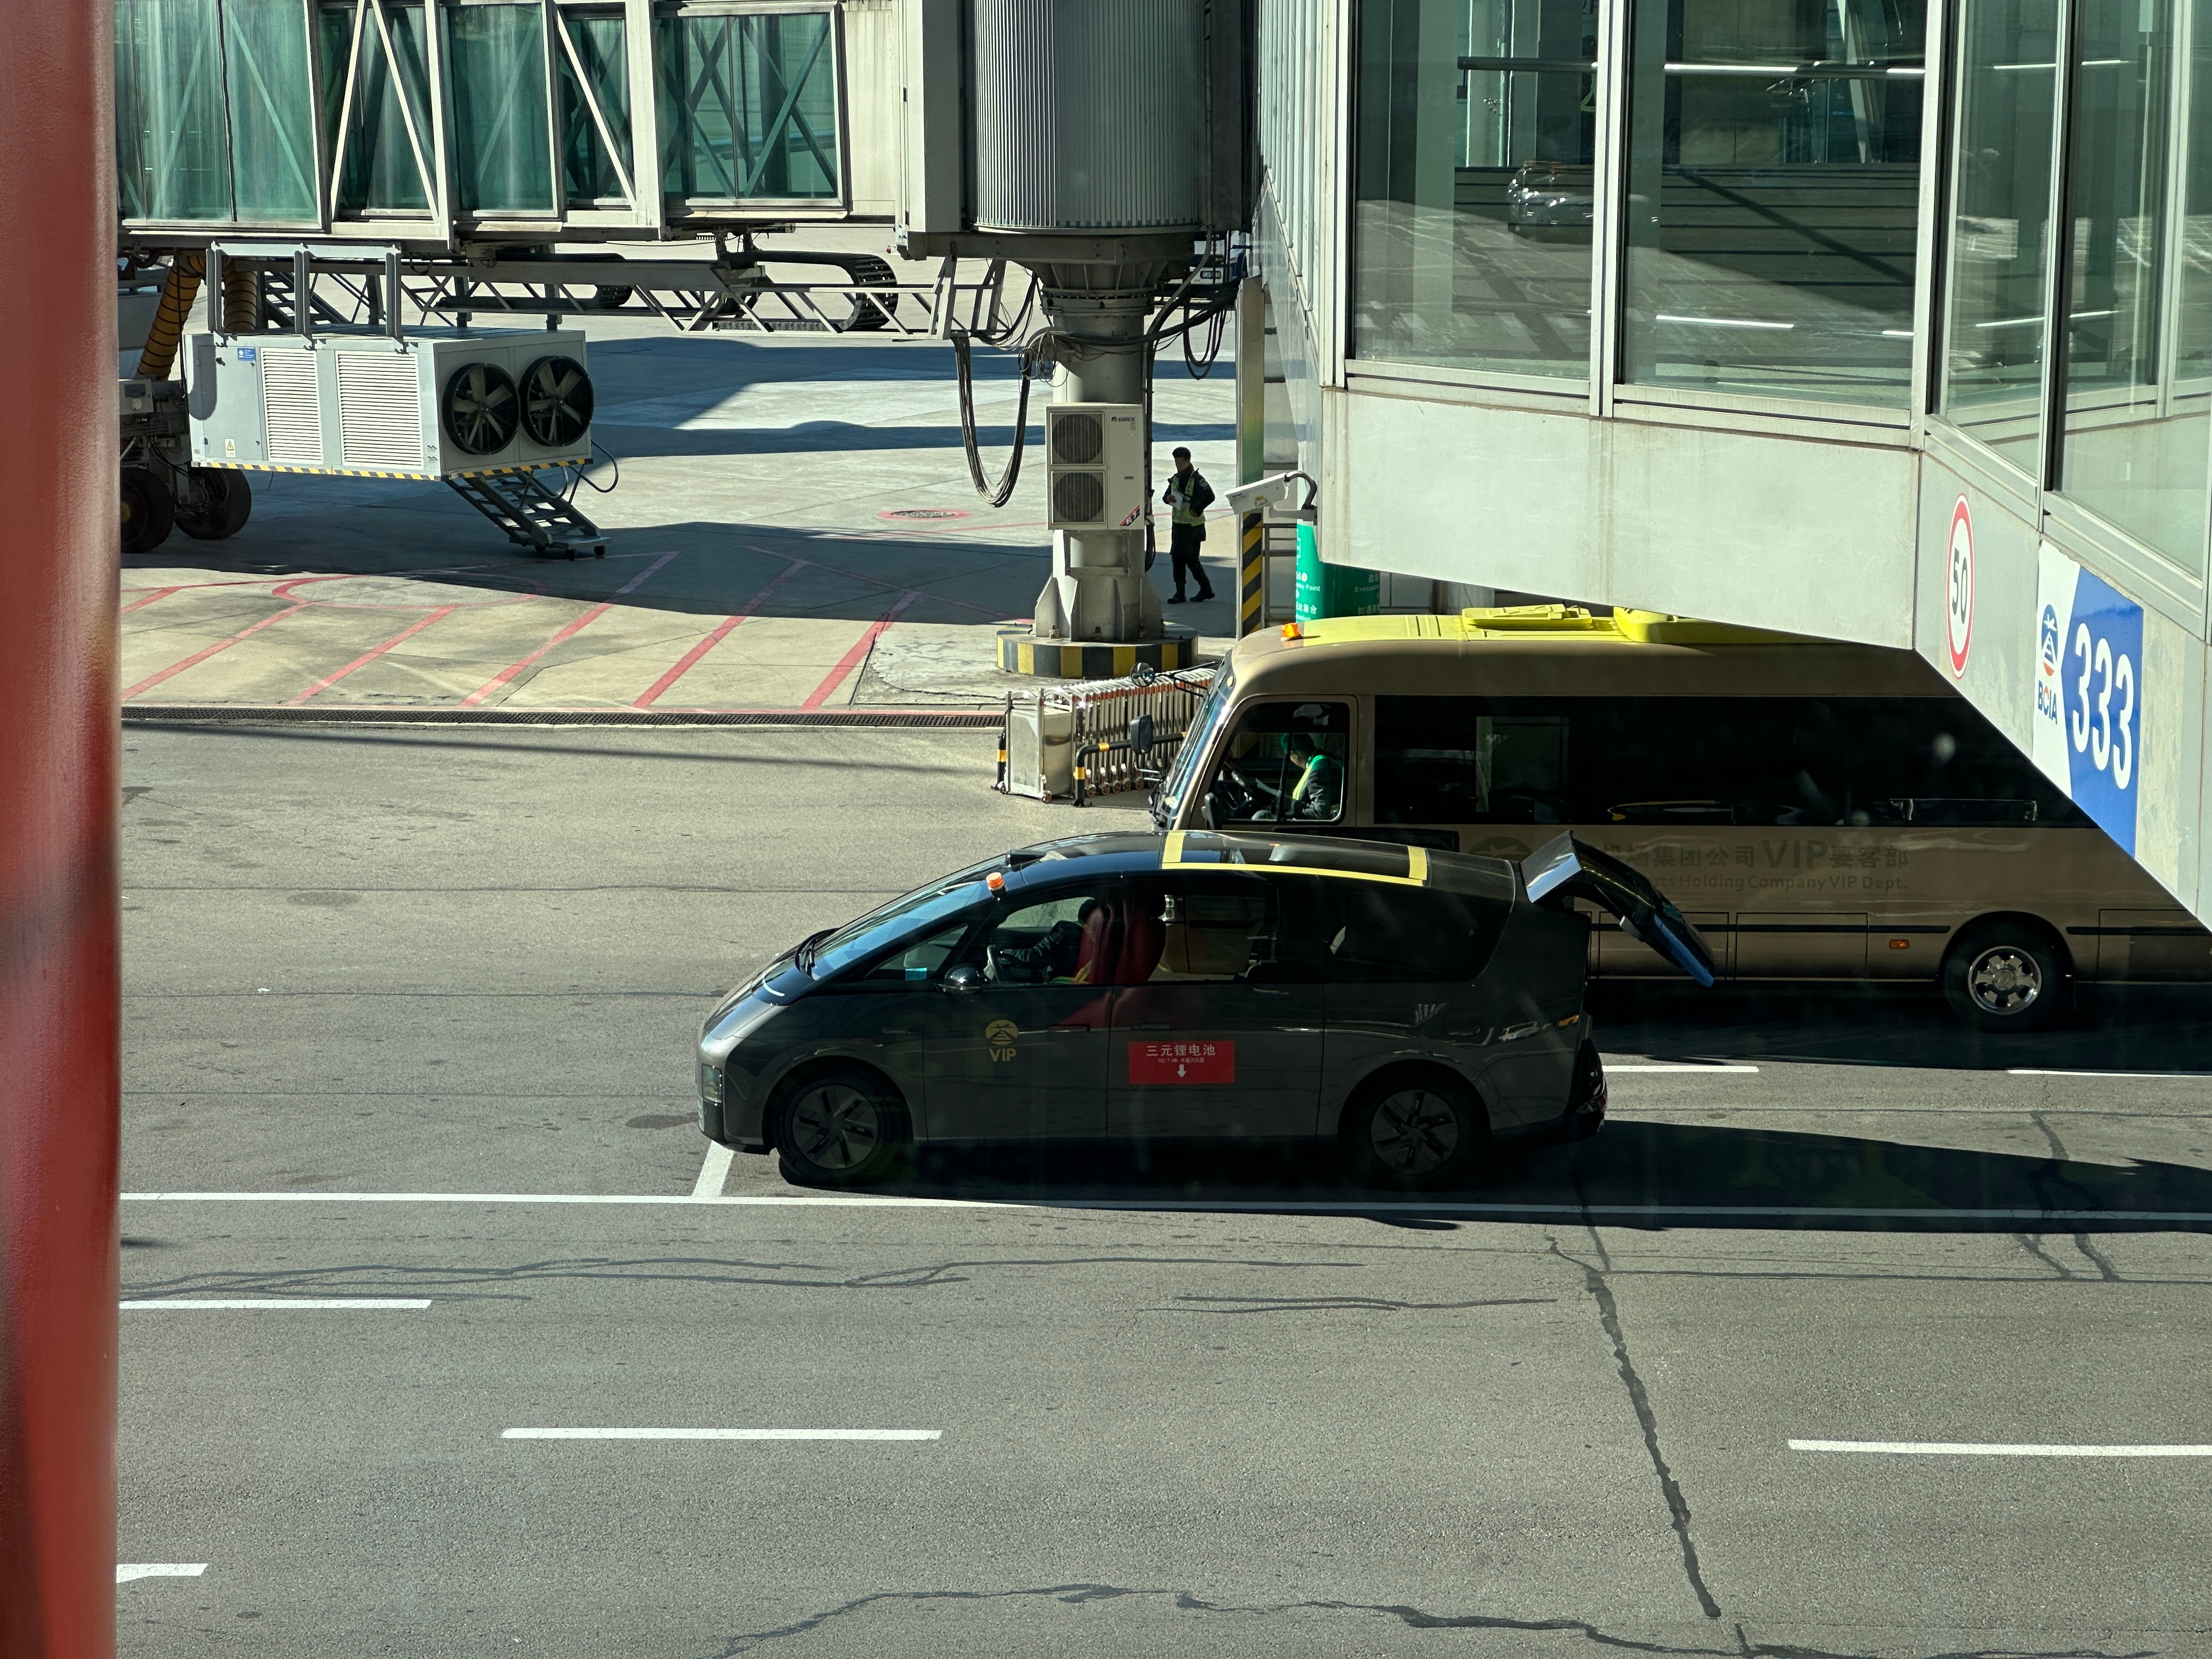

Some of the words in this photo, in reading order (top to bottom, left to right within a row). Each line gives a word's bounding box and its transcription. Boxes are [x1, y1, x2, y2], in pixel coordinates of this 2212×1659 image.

[1305, 583, 1321, 592] Point
[1951, 547, 1968, 625] 50
[2038, 681, 2058, 725] BCIA
[2071, 622, 2134, 790] 333
[1679, 874, 1743, 891] Holding
[1748, 875, 1827, 892] Company
[1829, 876, 1857, 889] VIP
[1862, 876, 1908, 892] Dept.
[989, 1048, 1017, 1062] VIP
[1146, 1043, 1216, 1057] 三元锂电池
